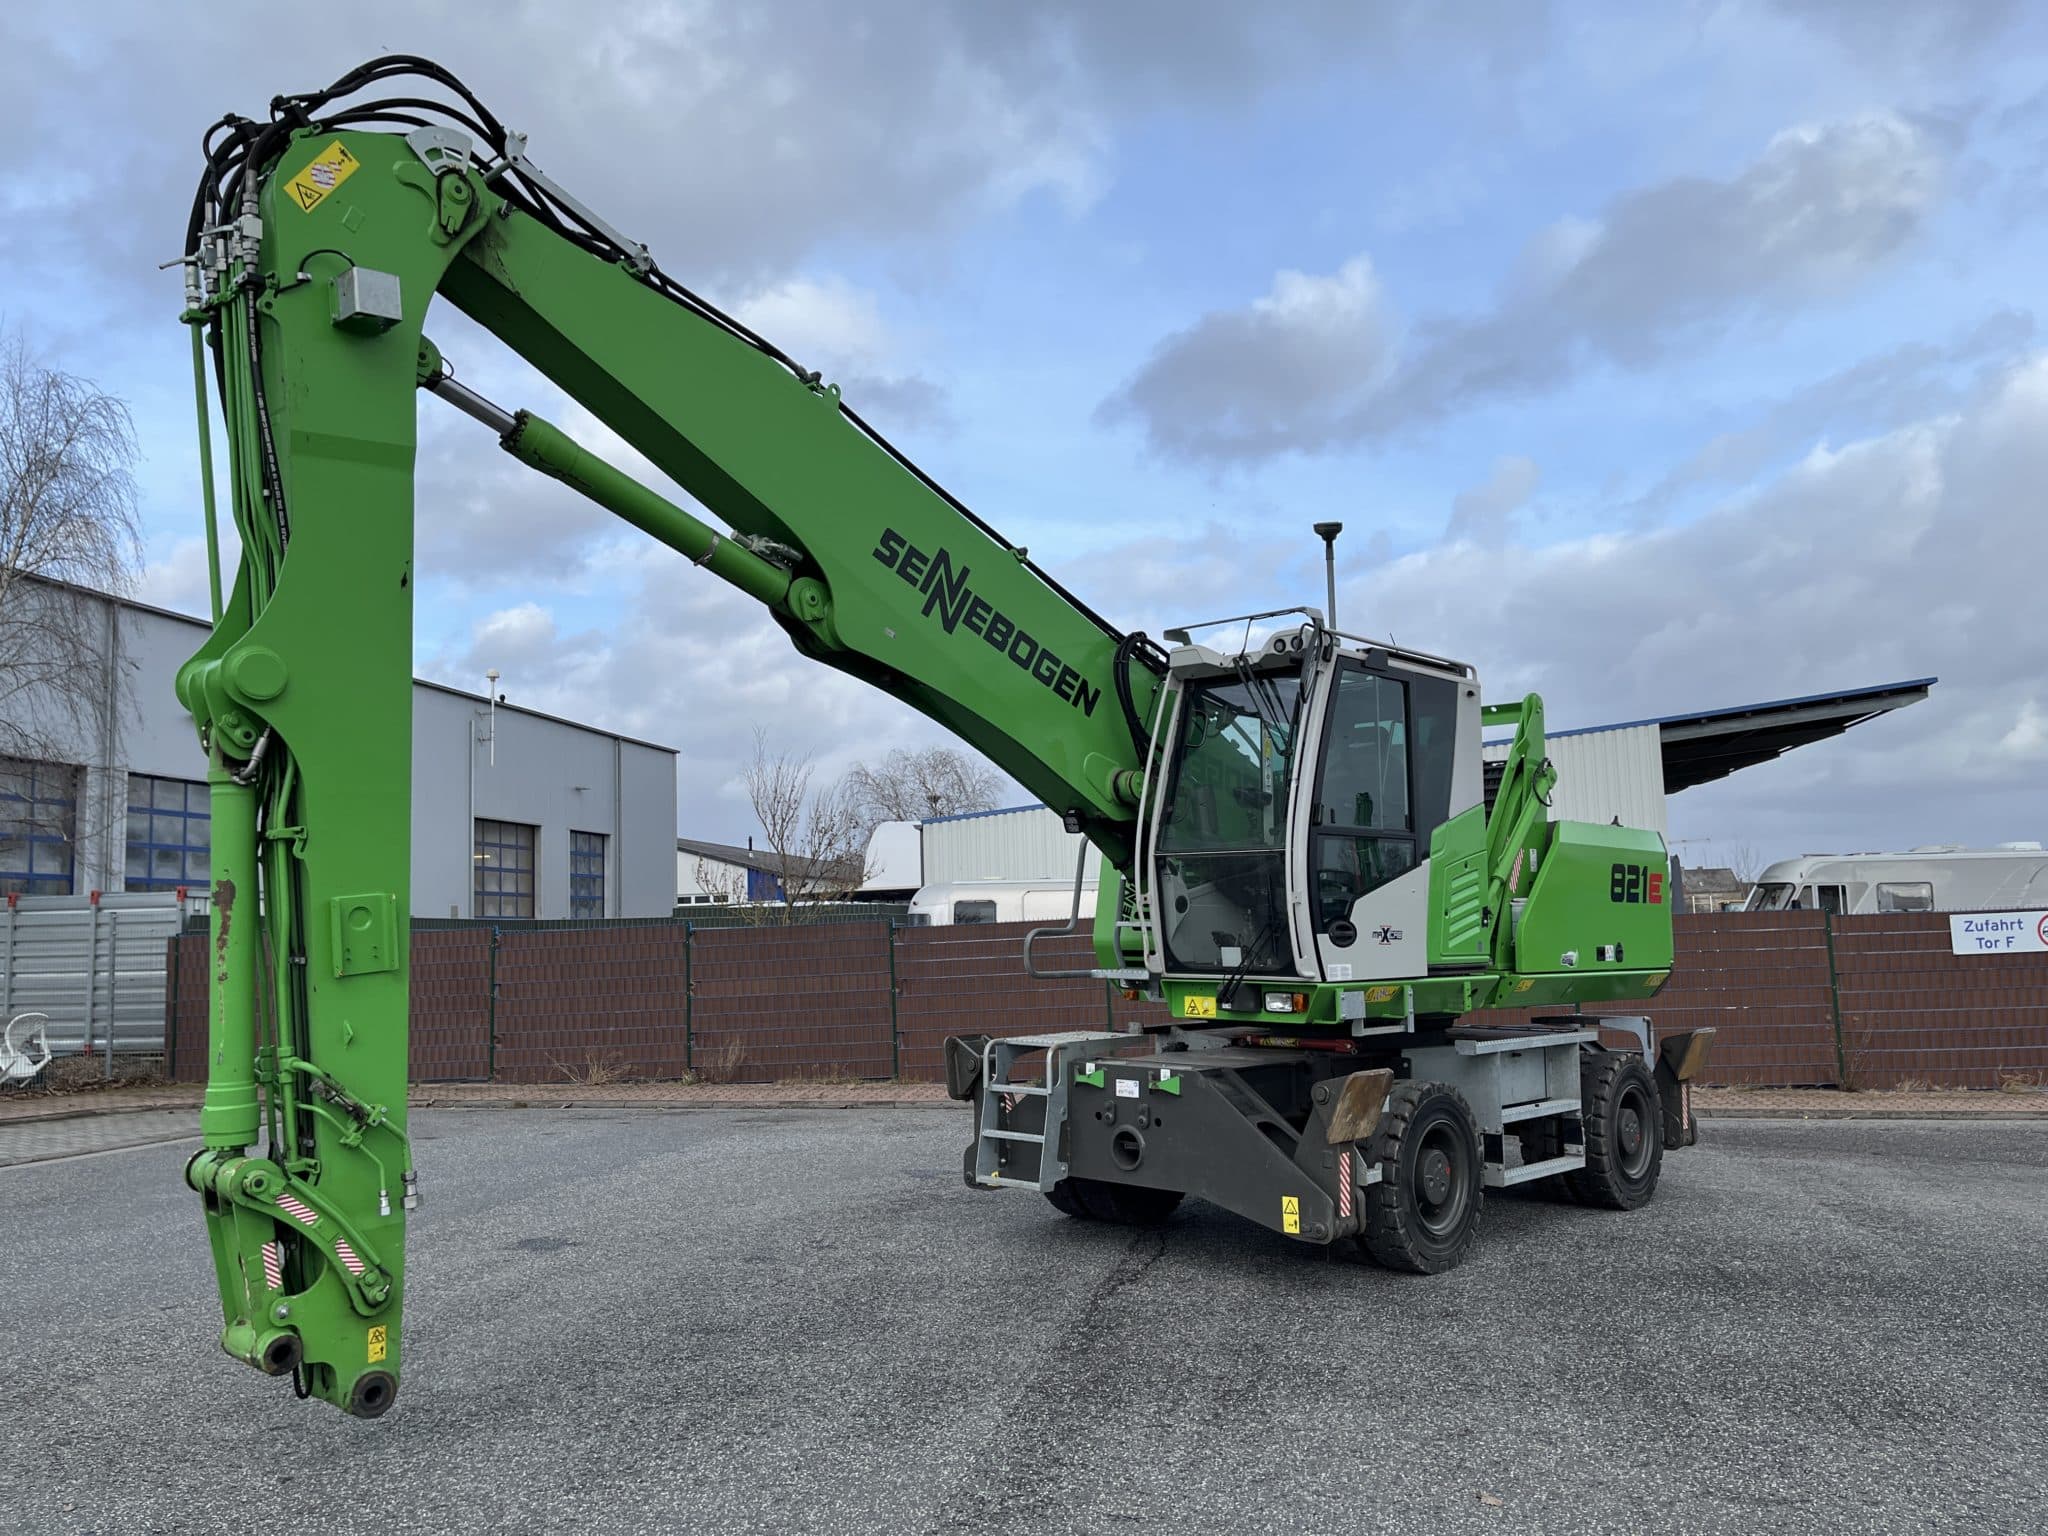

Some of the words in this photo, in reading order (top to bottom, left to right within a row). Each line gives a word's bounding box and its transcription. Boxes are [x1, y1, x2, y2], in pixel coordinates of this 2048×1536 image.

[872, 527, 1101, 718] SENNEBOGEN
[1611, 863, 1663, 904] 821E
[1964, 919, 2024, 932] Zufahrt
[1976, 937, 2000, 949] Tor
[2006, 936, 2015, 948] F
